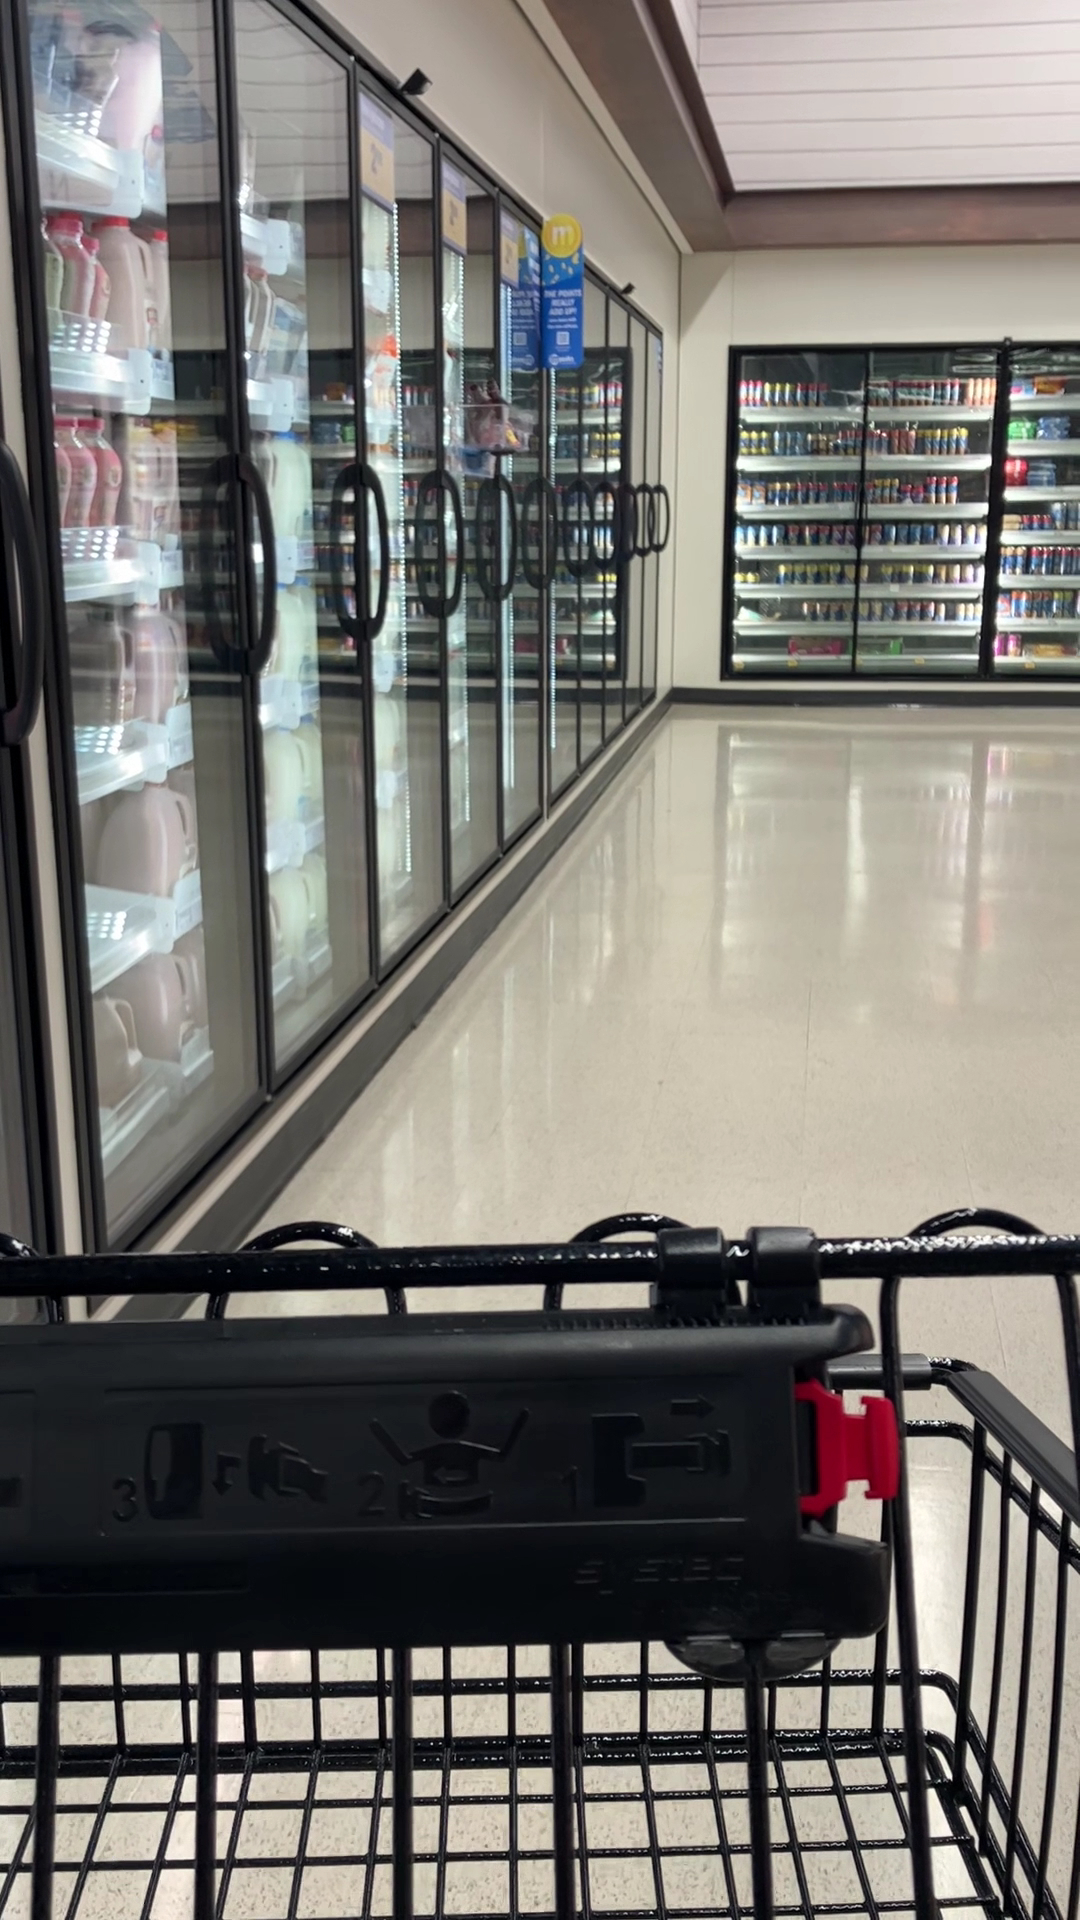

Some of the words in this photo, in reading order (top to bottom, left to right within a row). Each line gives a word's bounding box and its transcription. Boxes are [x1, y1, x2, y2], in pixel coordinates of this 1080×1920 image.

[552, 226, 575, 246] m
[551, 299, 576, 307] REALLY
[558, 289, 582, 298] POINTS
[112, 1477, 138, 1522] 3
[357, 1471, 386, 1517] 2
[559, 1465, 578, 1512] 1
